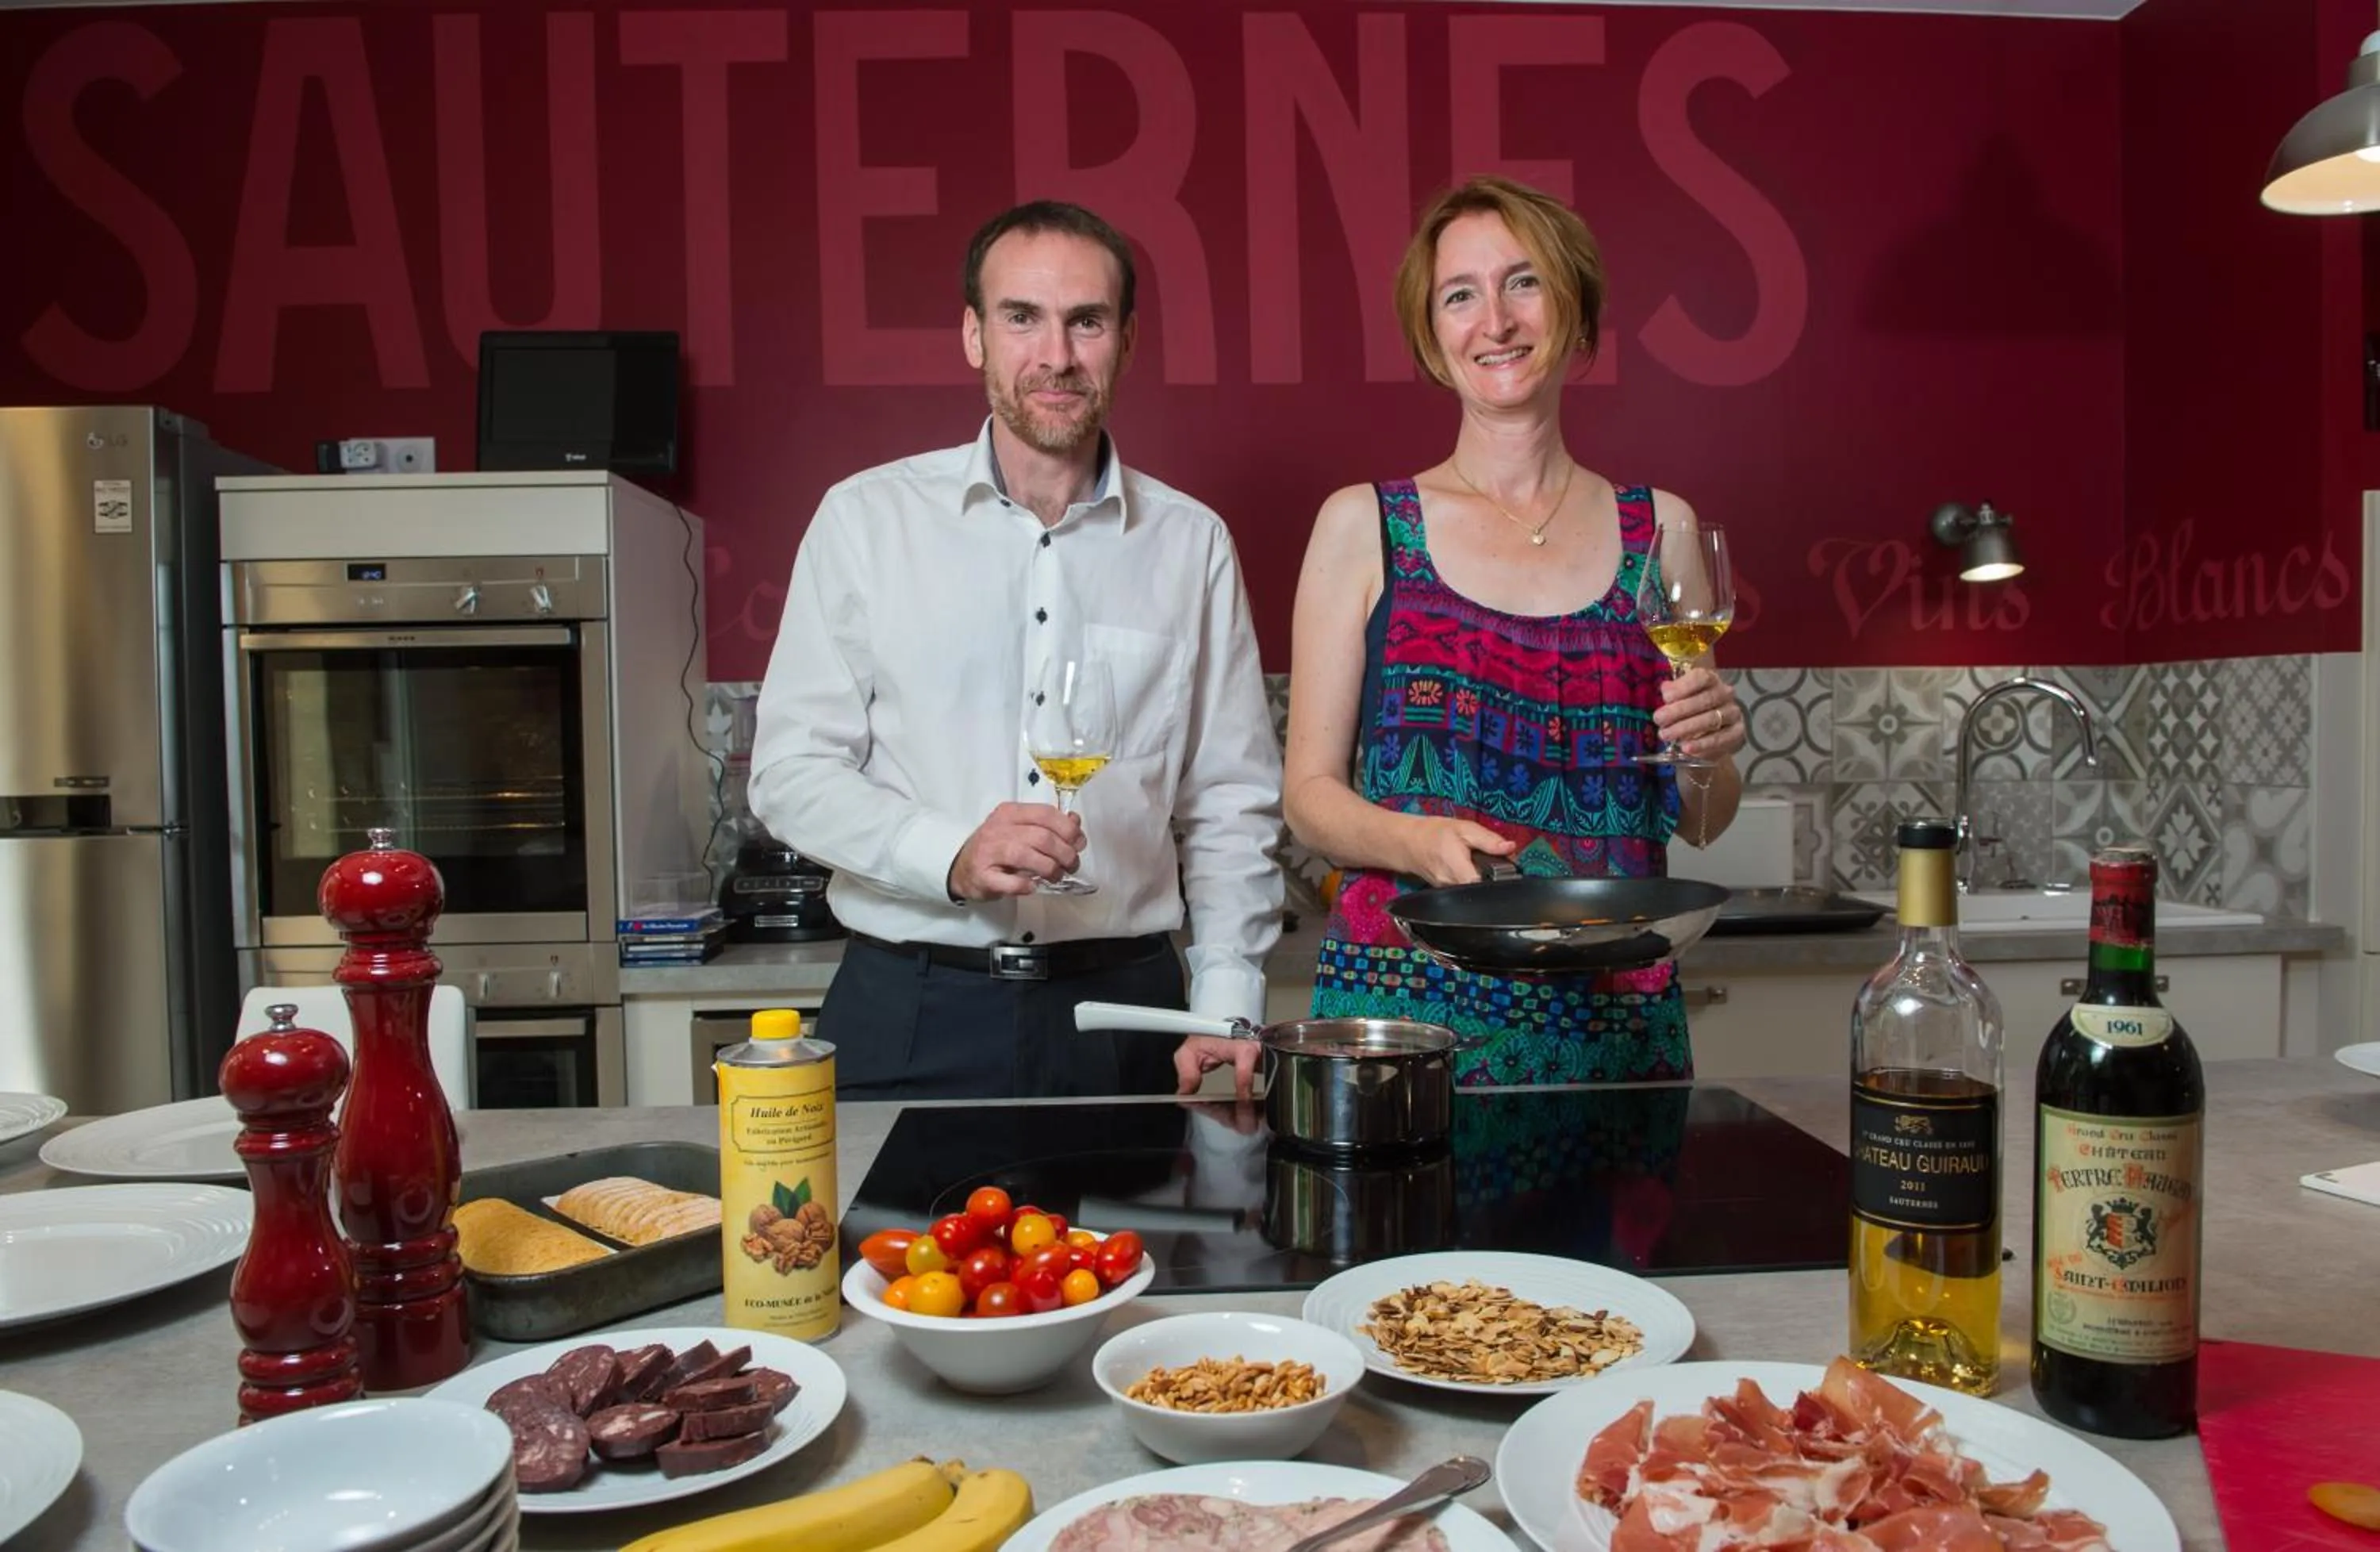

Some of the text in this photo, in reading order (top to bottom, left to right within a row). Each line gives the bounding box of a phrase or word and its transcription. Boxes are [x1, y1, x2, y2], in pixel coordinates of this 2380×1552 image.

[20, 10, 1809, 394] SAUTERNES
[1806, 536, 2031, 640] Vins
[2098, 517, 2351, 632] Blancs
[2107, 1020, 2144, 1035] 1961
[750, 1107, 782, 1118] Huile
[785, 1107, 798, 1117] de
[1868, 1133, 1892, 1144] GRAND
[1894, 1137, 1911, 1147] CRU
[2109, 1128, 2134, 1141] Cru
[1857, 1146, 1912, 1171] ATEAU
[1900, 1180, 1926, 1192] 2011
[1889, 1196, 1938, 1209] SAUTERNES
